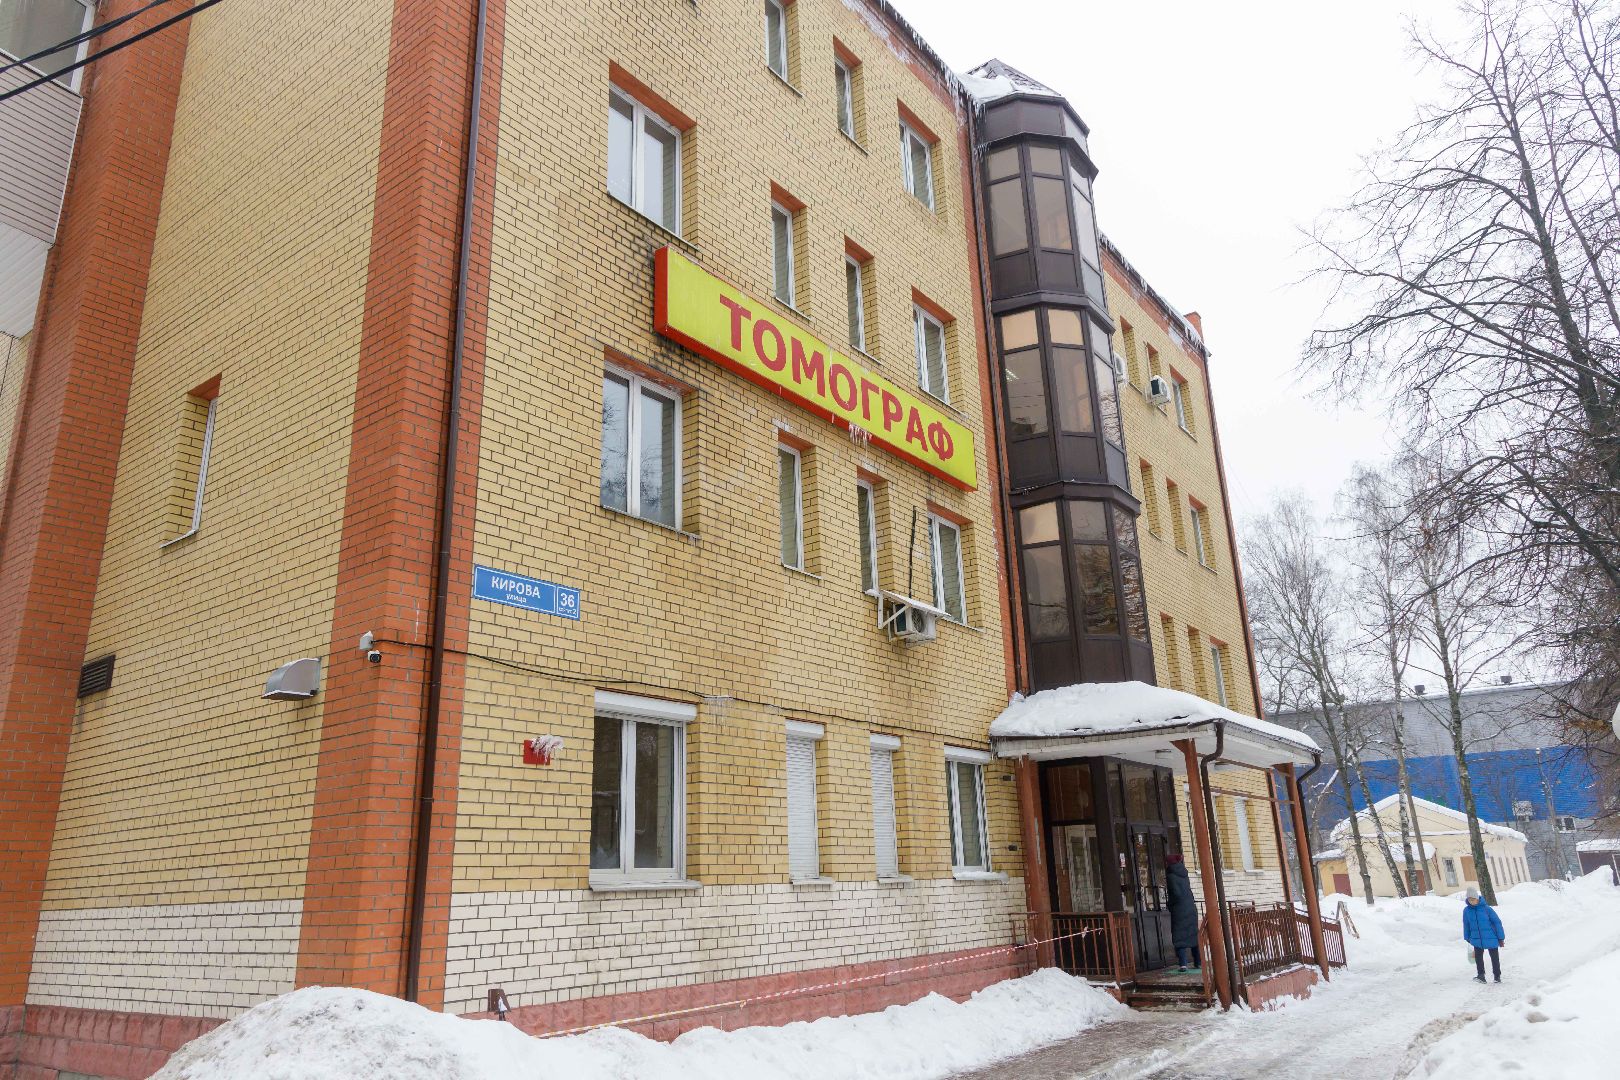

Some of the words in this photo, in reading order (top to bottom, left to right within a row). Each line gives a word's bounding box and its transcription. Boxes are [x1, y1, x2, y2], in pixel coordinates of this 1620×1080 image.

[720, 293, 954, 461] ТОМОГРАФ
[491, 576, 541, 599] КИРОВА
[506, 593, 527, 604] улица
[560, 592, 575, 607] 36
